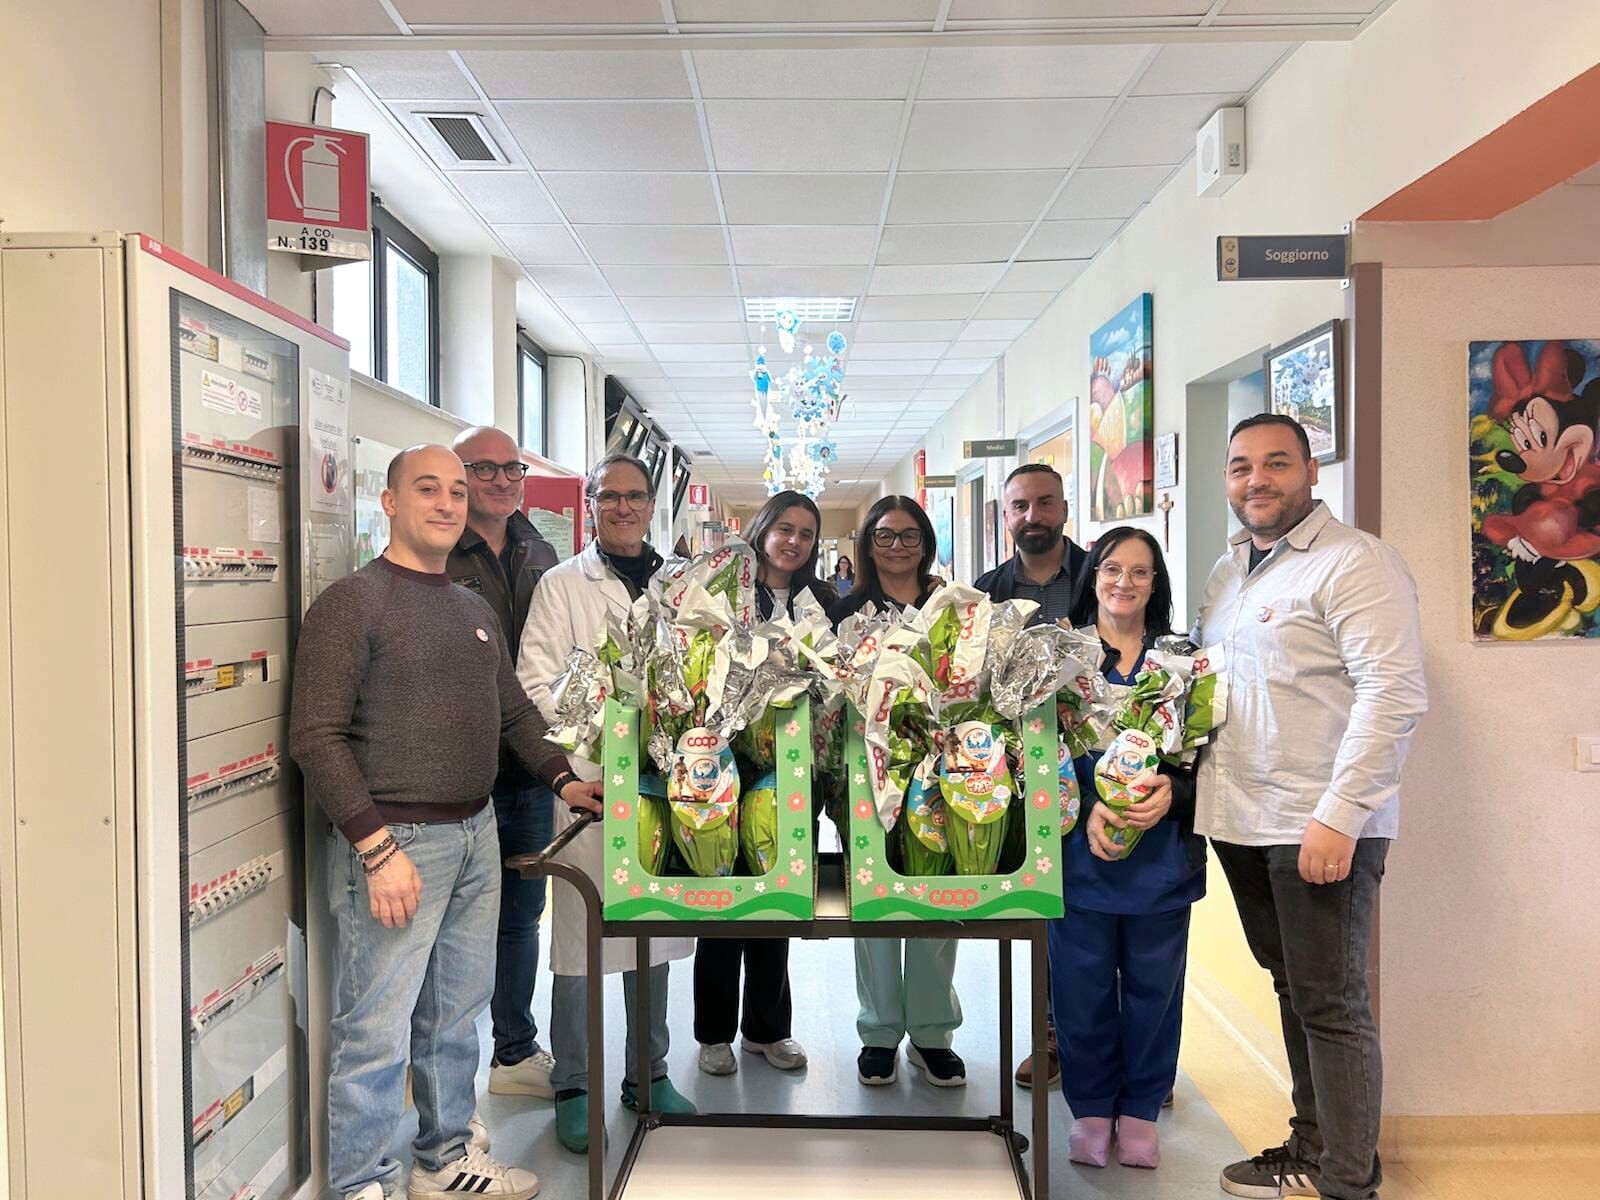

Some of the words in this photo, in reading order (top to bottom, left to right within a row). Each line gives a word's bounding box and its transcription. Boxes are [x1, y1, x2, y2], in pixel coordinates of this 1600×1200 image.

[301, 227, 309, 236] A
[278, 236, 293, 249] N.
[299, 236, 329, 251] 139
[1265, 248, 1329, 264] Soggiorno
[1193, 658, 1209, 673] op
[687, 736, 718, 749] coop
[1125, 734, 1149, 749] coop
[684, 890, 733, 909] coop
[929, 889, 979, 909] coop
